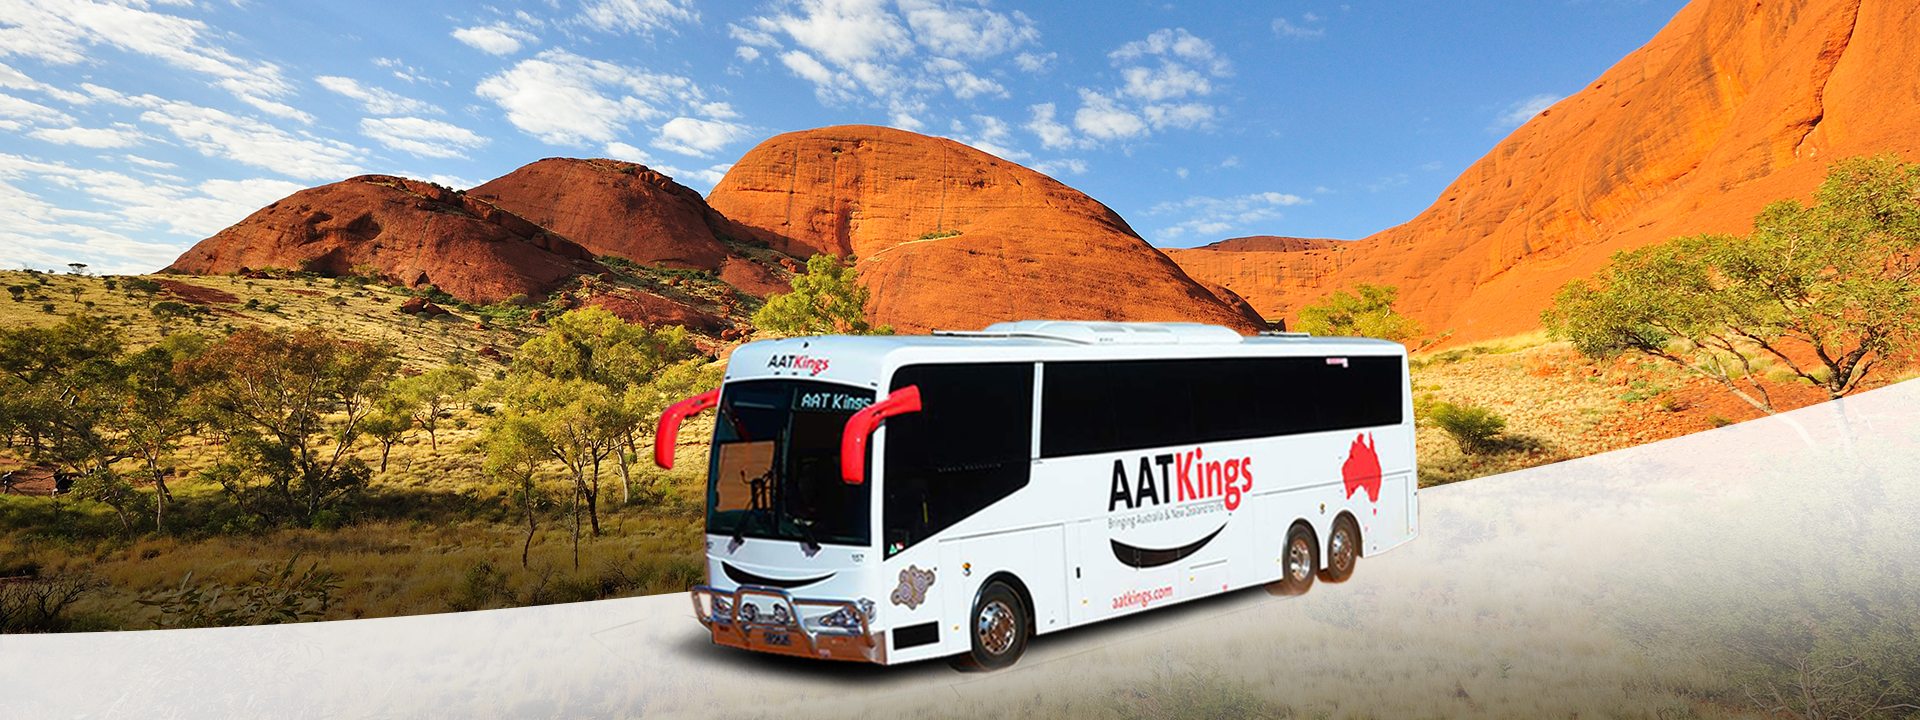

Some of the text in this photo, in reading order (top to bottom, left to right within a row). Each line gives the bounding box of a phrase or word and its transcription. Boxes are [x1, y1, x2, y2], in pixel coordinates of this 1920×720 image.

[767, 354, 830, 376] AATKings
[801, 393, 830, 408] AAT
[1108, 447, 1253, 511] AATKings
[1108, 517, 1136, 530] Bringing
[1137, 512, 1163, 524] Australia
[1112, 586, 1173, 610] aatkings.com
